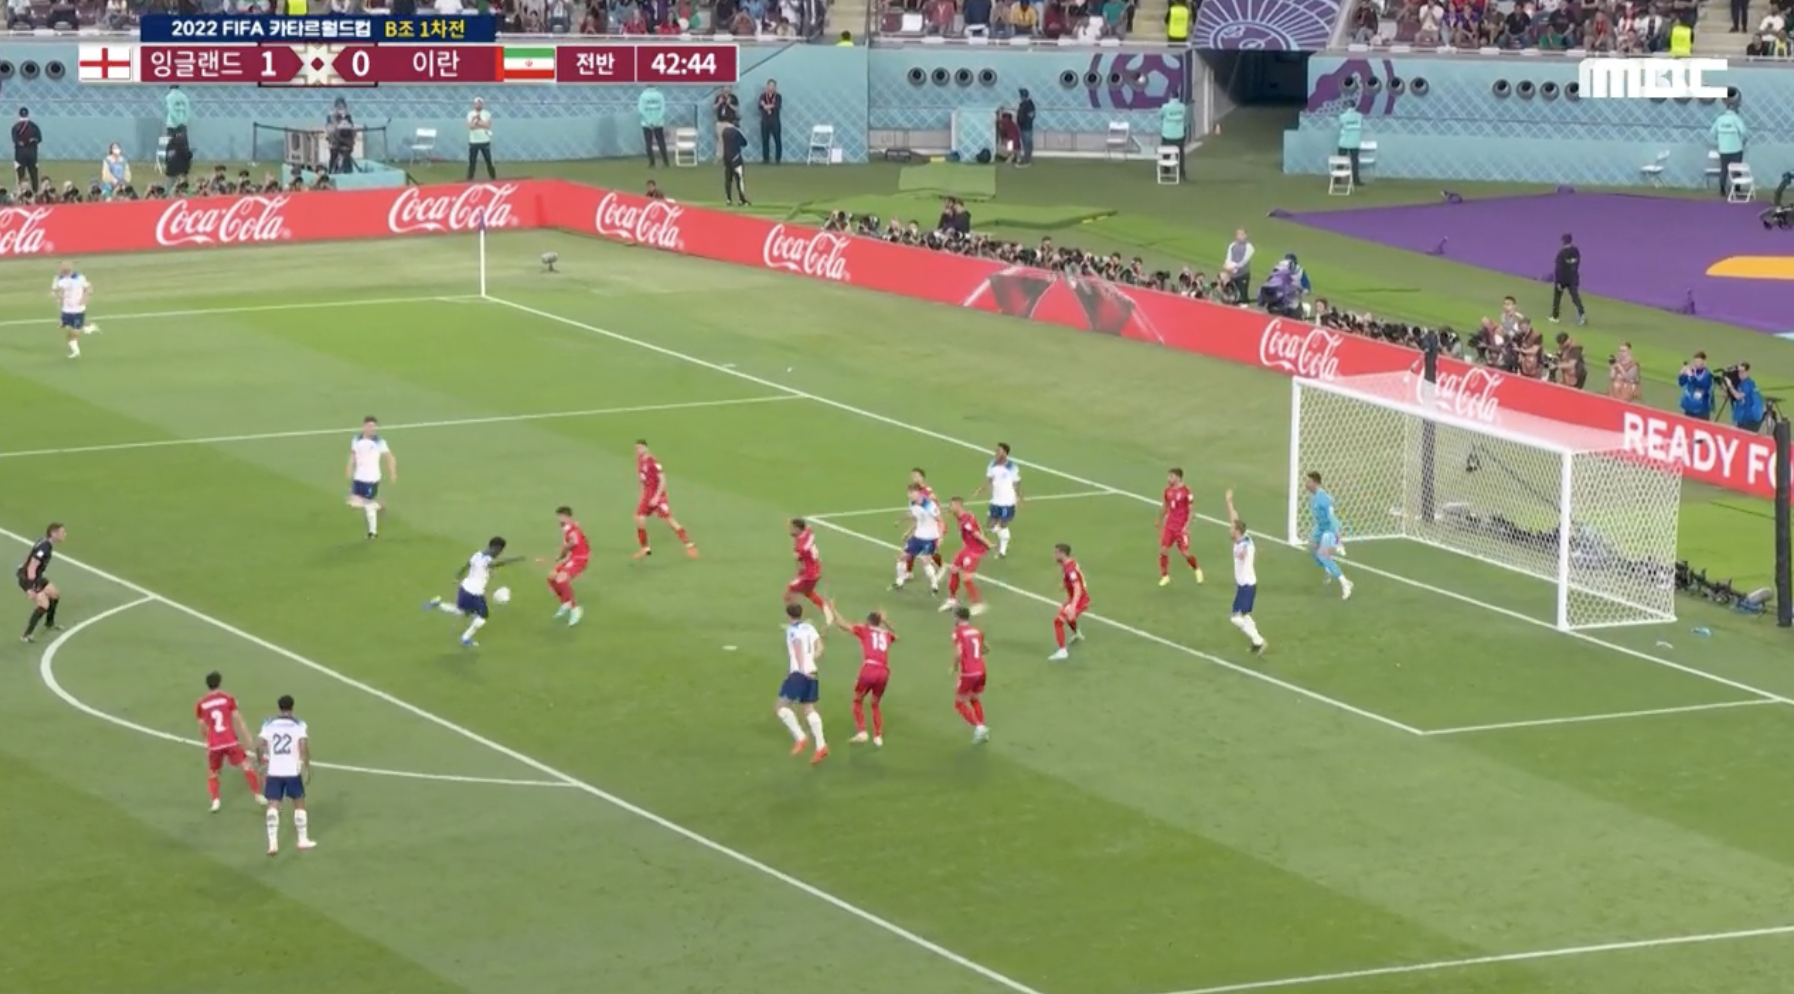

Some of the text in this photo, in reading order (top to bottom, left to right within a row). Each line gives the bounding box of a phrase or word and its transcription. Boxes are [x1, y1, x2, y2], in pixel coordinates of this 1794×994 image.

[155, 195, 292, 246] Coca-Cola
[387, 183, 519, 233] Coca-Cola
[595, 191, 684, 249] Coca-Cola
[763, 223, 851, 281] Coca-Cola
[1260, 317, 1345, 381] Coca-Cola
[1623, 411, 1740, 479] READY
[871, 631, 888, 652] 15
[211, 710, 226, 733] 2
[273, 734, 292, 754] 22
